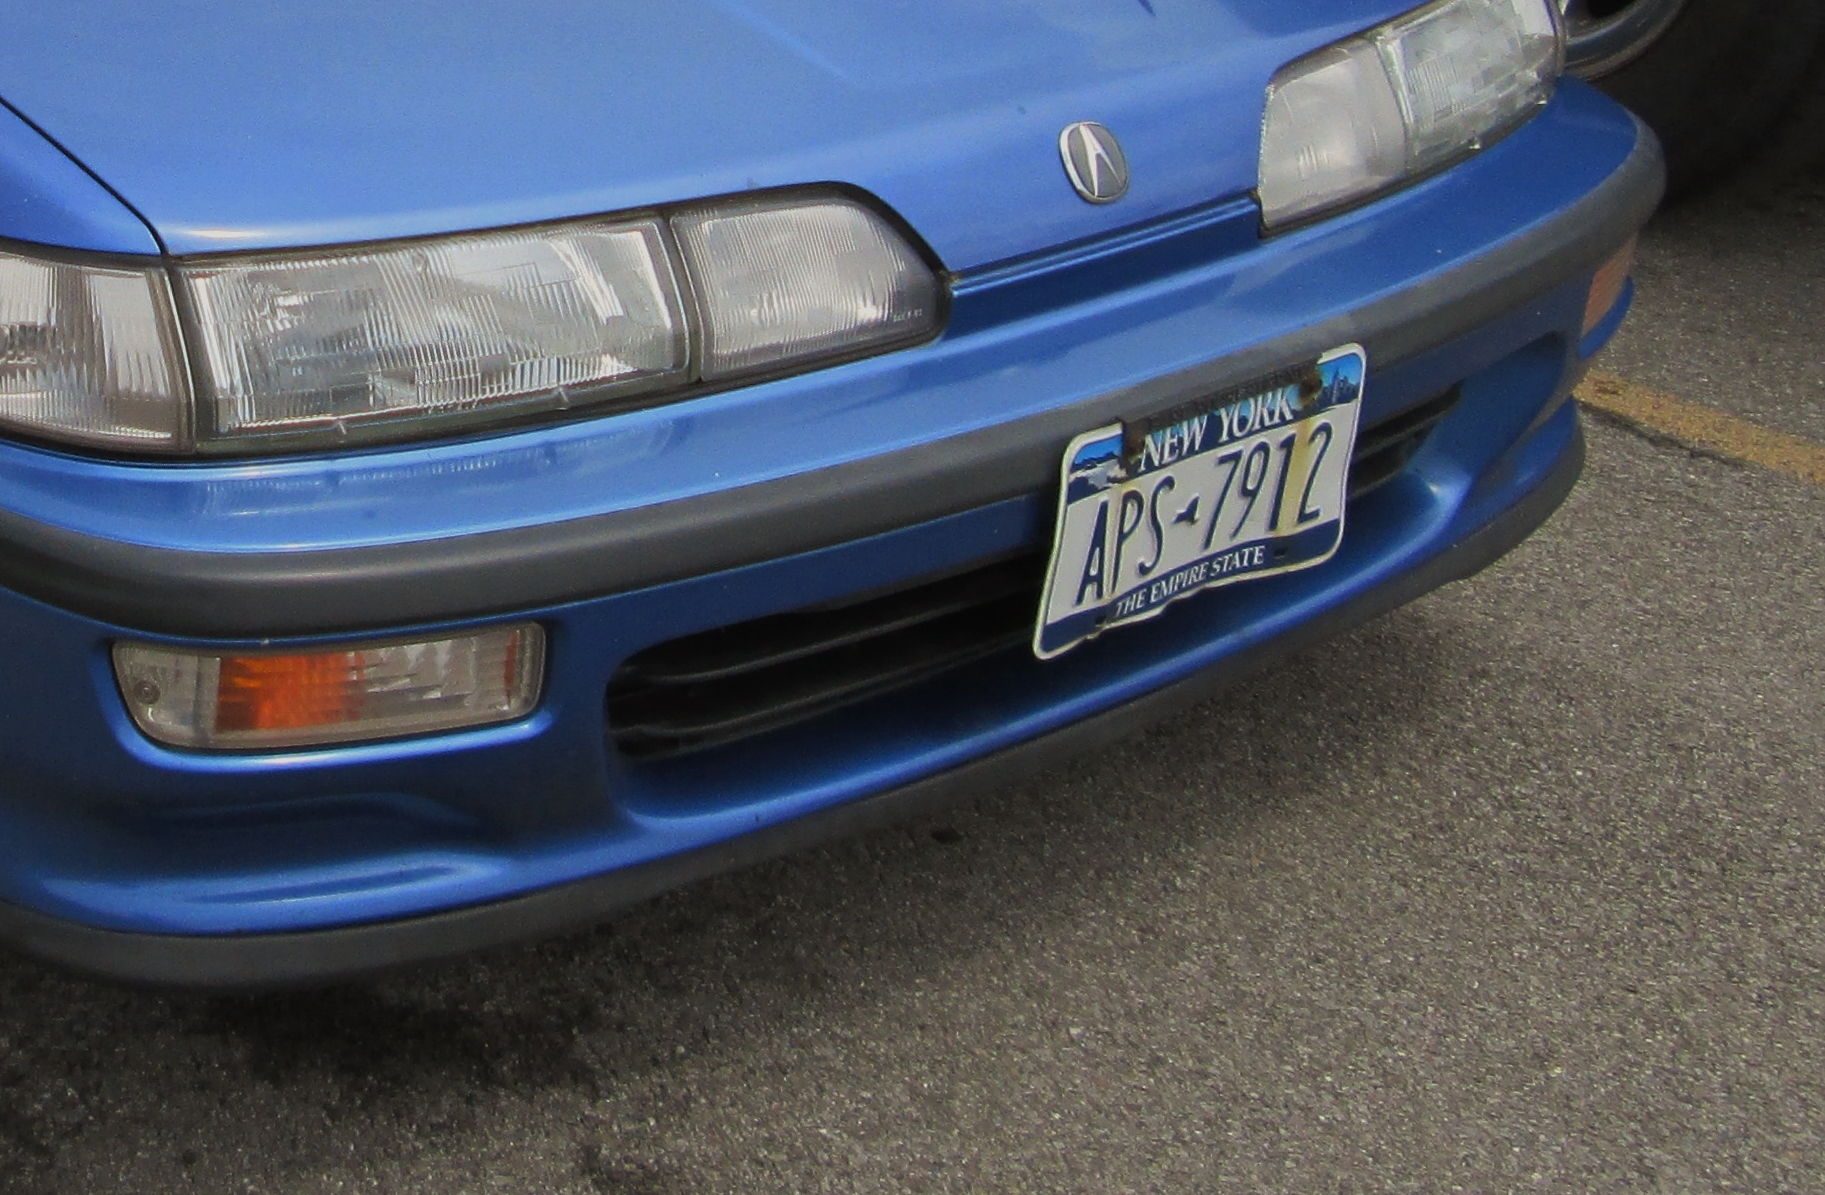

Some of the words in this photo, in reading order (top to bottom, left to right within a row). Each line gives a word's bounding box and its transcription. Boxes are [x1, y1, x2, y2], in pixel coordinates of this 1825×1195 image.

[1138, 414, 1208, 472] NEW
[1218, 388, 1294, 444] YORK
[1075, 475, 1176, 607] APS
[1203, 421, 1334, 552] 7912
[1115, 588, 1148, 617] THE
[1149, 561, 1210, 603] EMPIRE
[1210, 545, 1266, 577] STATE
